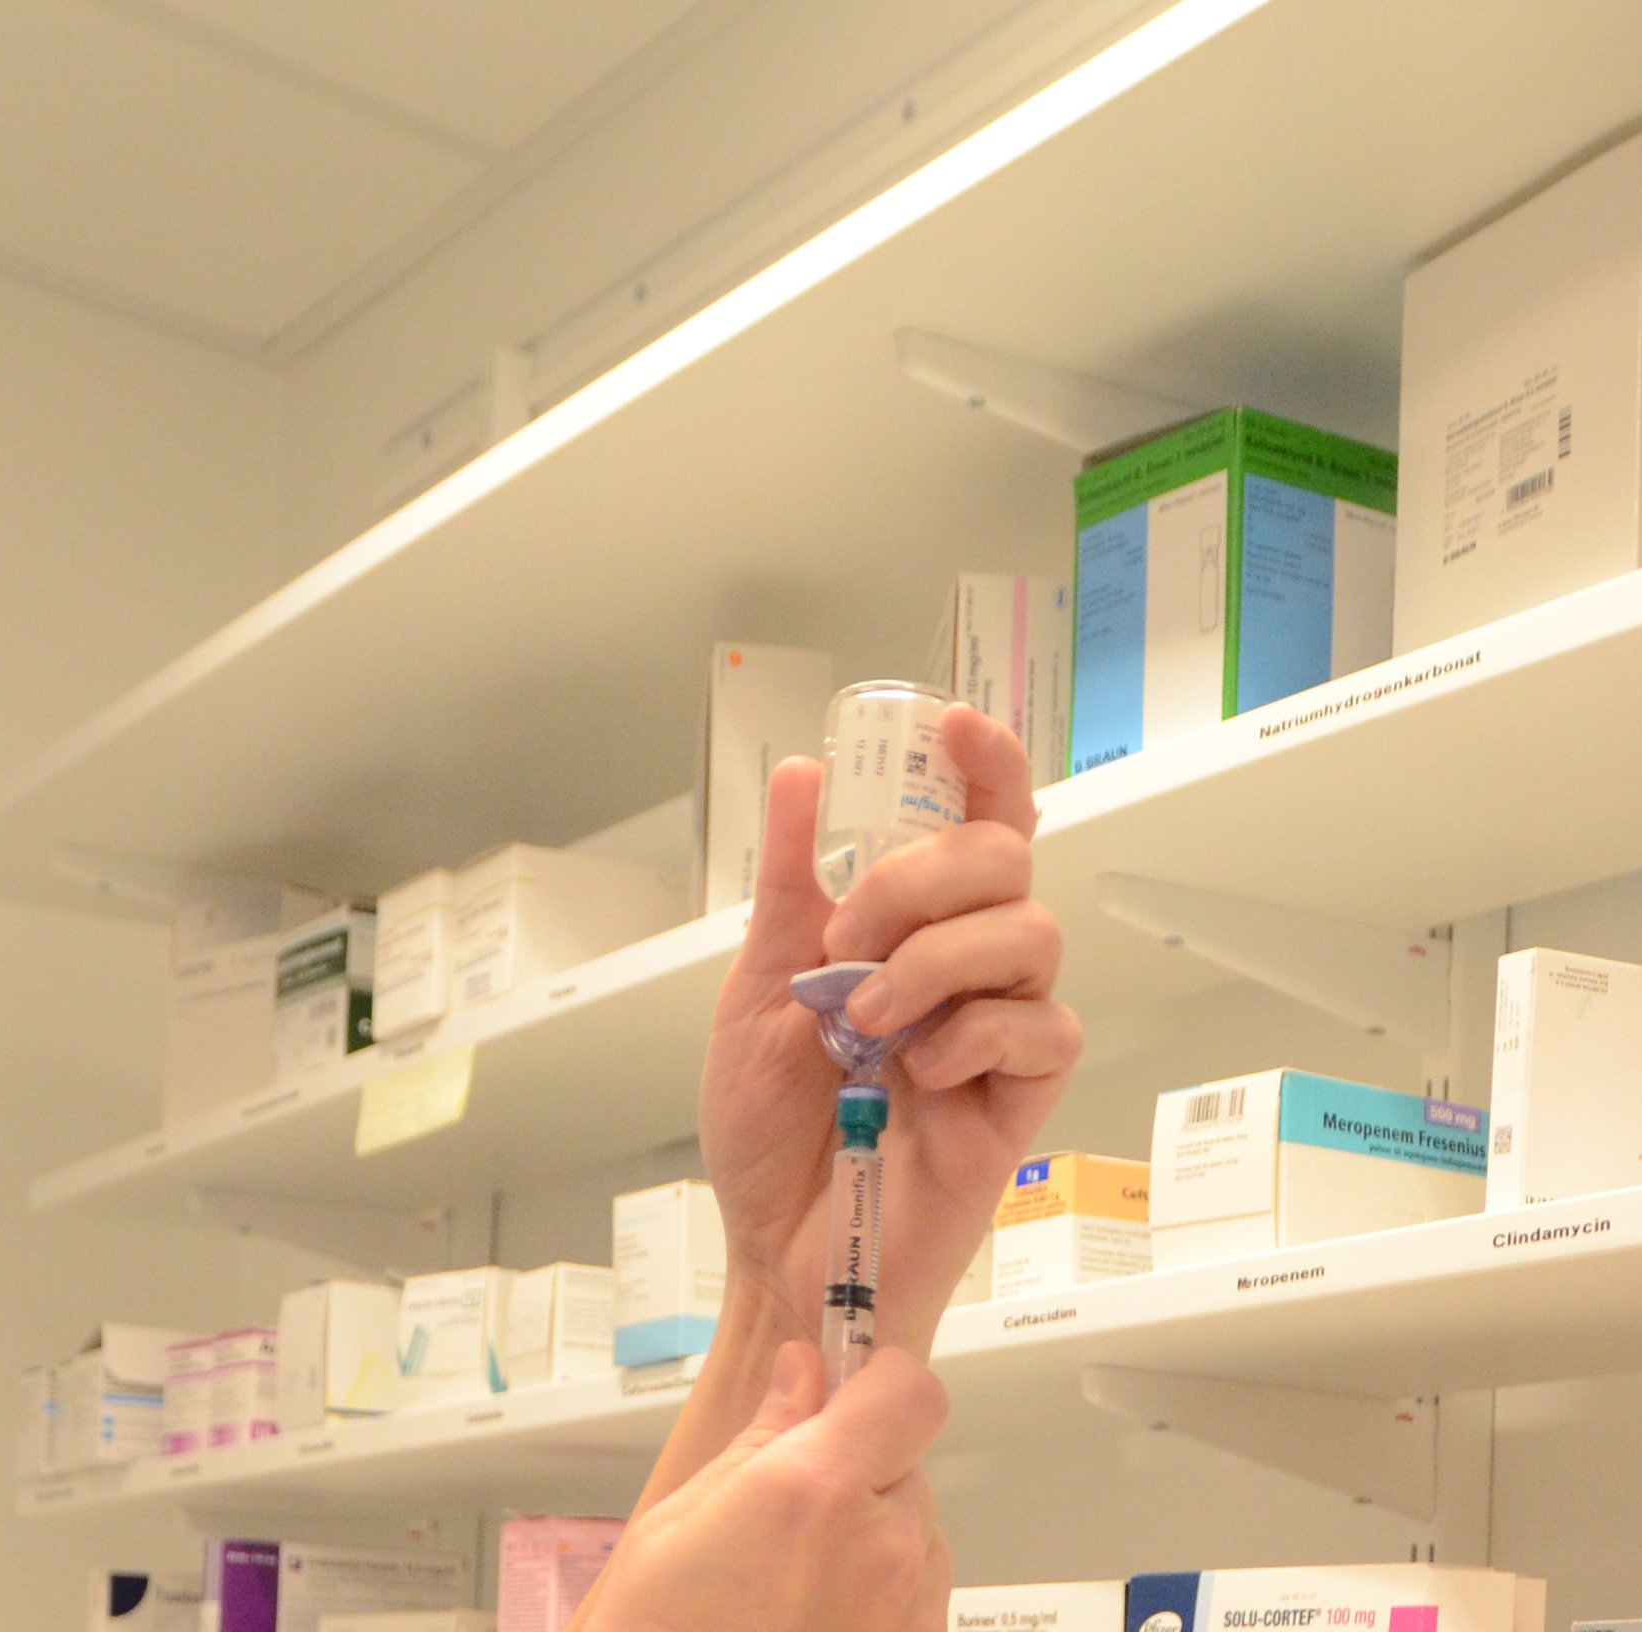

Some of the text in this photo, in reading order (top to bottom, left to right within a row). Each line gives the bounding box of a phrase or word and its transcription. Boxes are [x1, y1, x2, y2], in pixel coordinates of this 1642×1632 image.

[1259, 649, 1483, 739] Natriumhydrogenkarbonat
[1086, 744, 1129, 769] BRAUN
[1322, 1111, 1487, 1159] Meropenem Fresenius
[849, 1168, 866, 1229] Omnifix
[1492, 1216, 1611, 1250] Clindamycin
[1327, 1608, 1352, 1627] 100
[1354, 1608, 1376, 1628] mg
